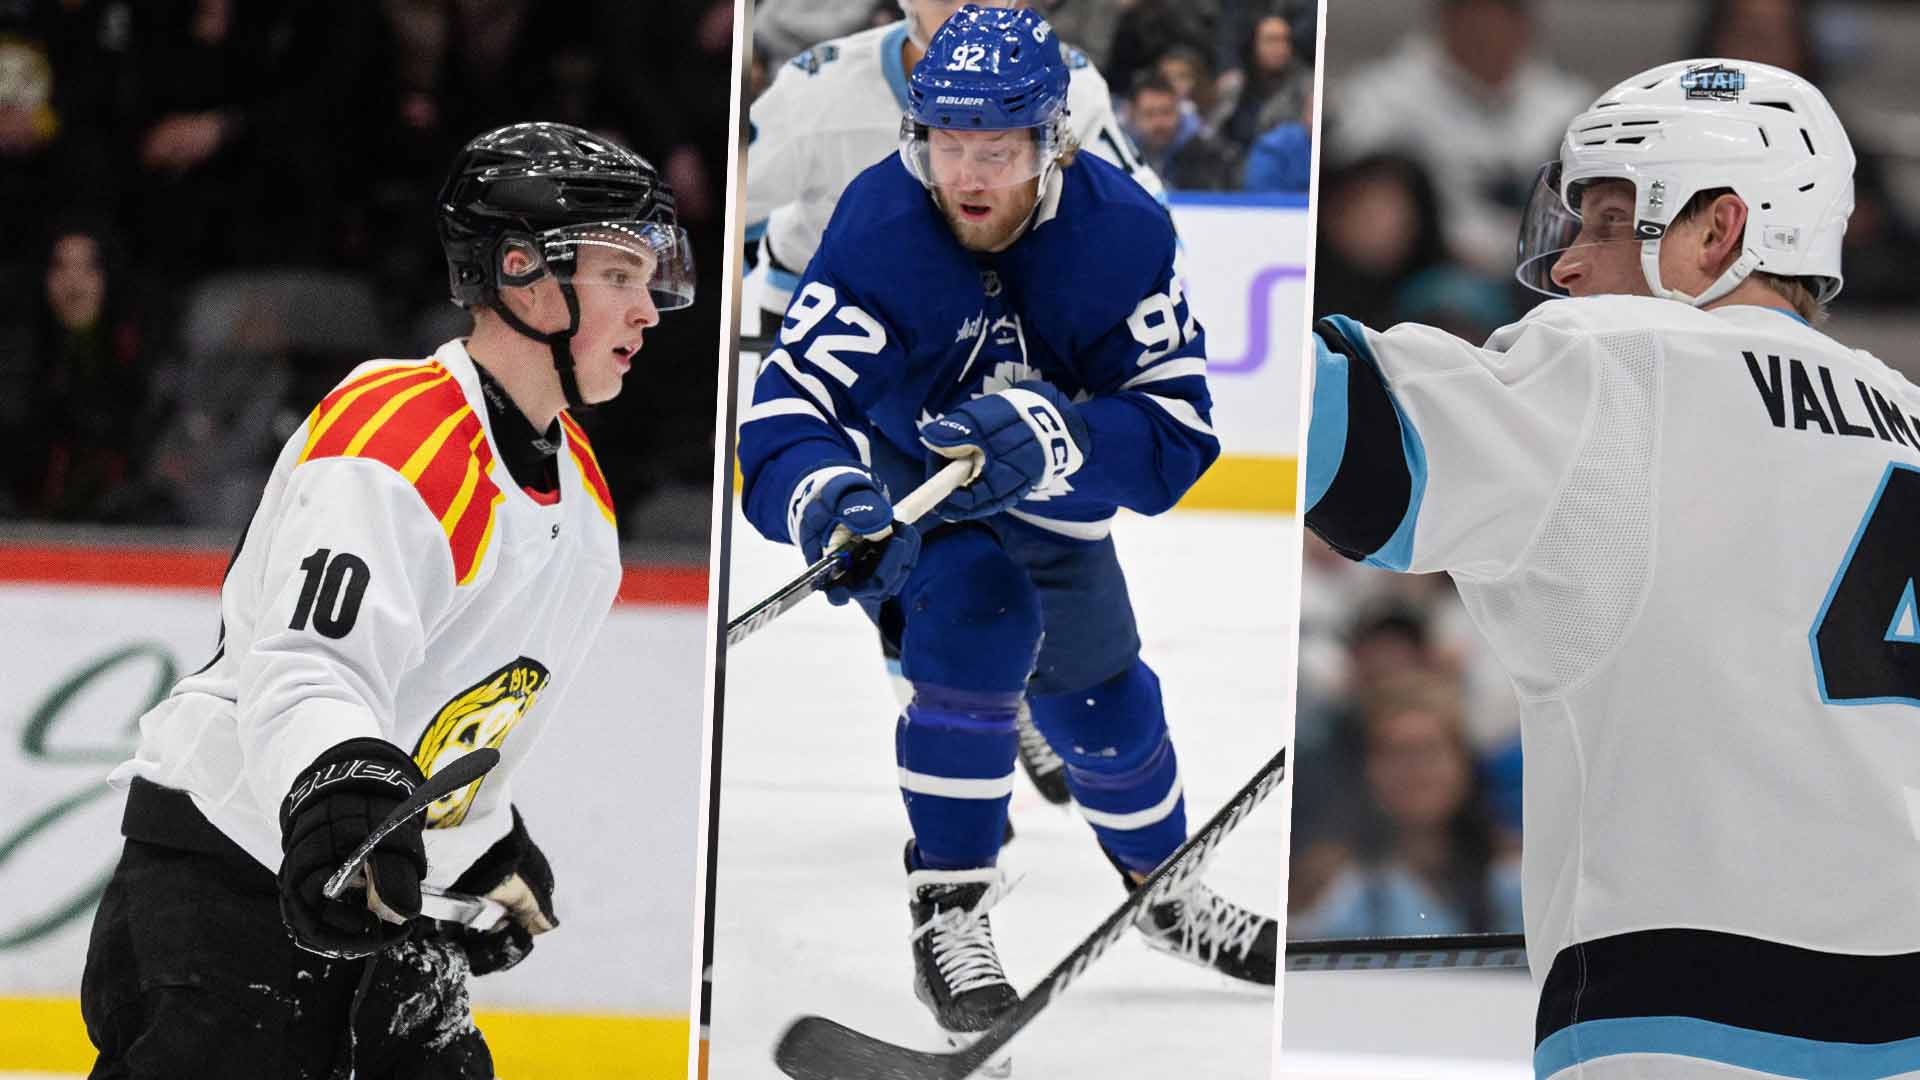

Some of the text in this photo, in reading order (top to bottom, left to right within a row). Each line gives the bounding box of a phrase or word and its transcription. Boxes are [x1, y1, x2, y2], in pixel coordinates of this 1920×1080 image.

[946, 45, 985, 71] 92
[1680, 72, 1745, 89] UTAH
[936, 96, 984, 105] BAUER
[781, 281, 887, 388] 92
[1742, 351, 1920, 452] VALIM
[939, 420, 972, 435] CCM
[1028, 406, 1068, 475] CC
[843, 505, 874, 515] CCM
[288, 548, 371, 640] 10
[1808, 460, 1920, 707] 4
